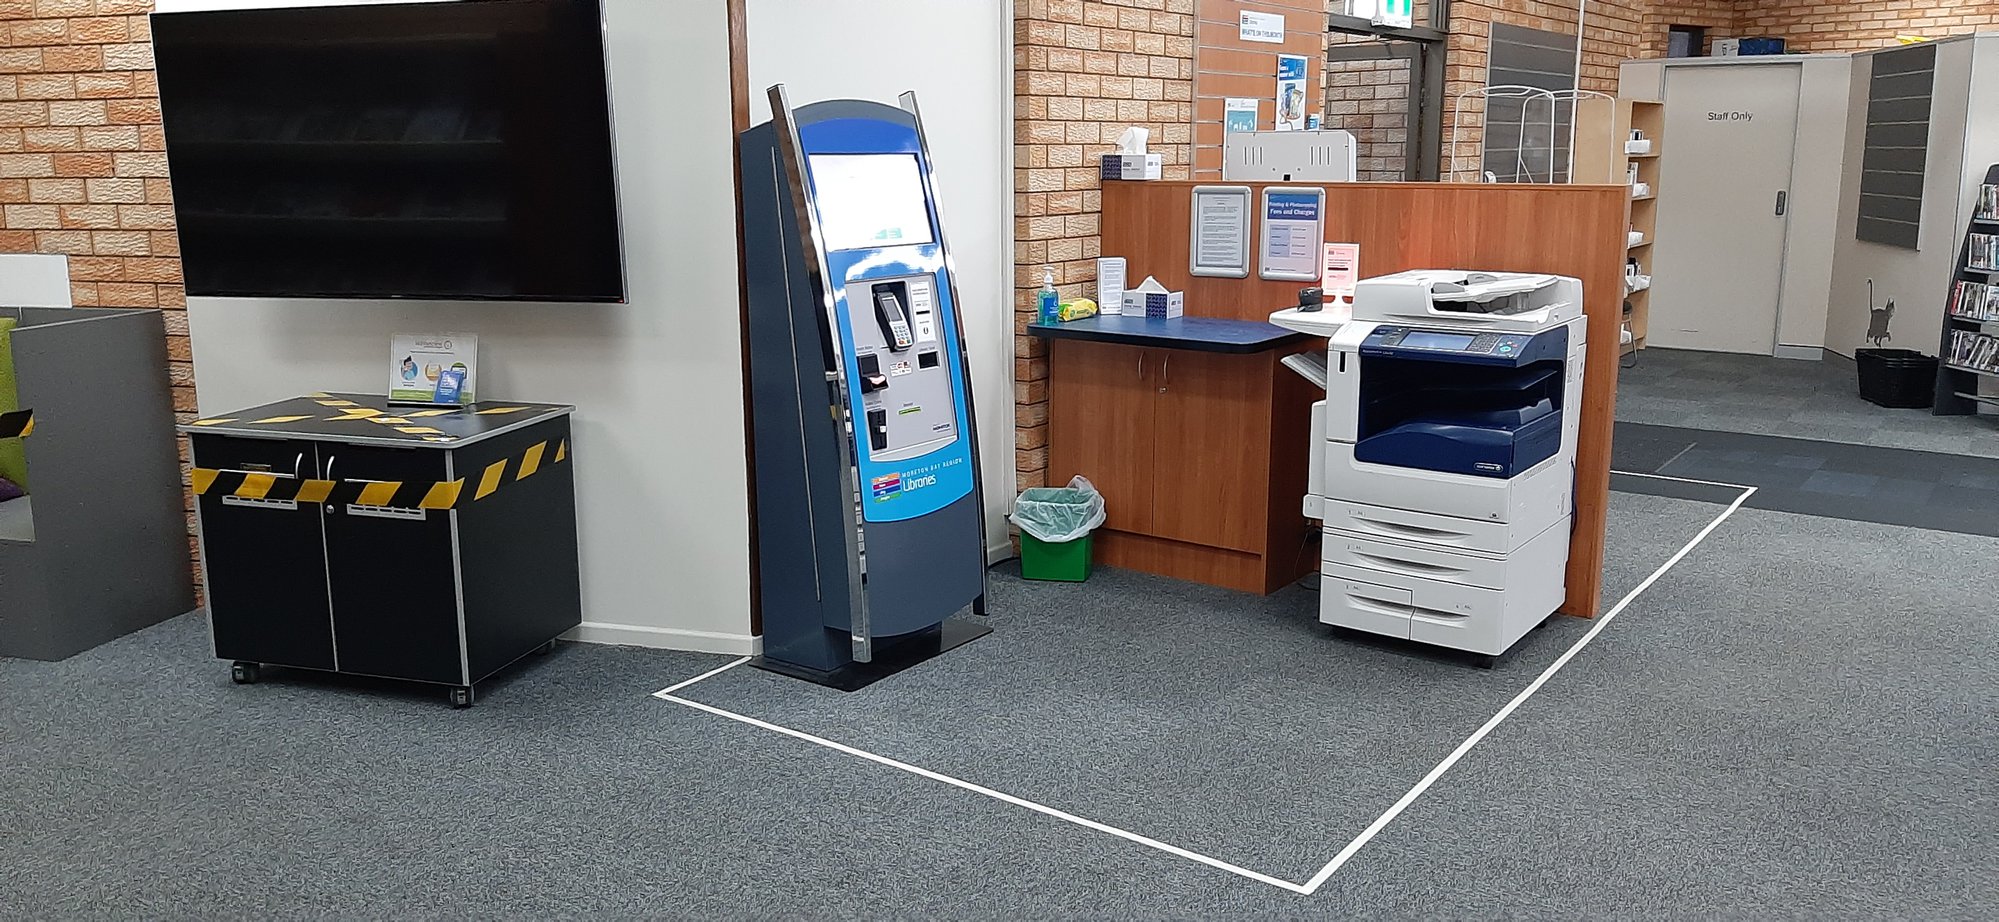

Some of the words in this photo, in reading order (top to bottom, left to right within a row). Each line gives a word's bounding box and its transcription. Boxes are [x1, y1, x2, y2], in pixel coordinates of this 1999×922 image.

[1707, 112, 1729, 121] Staff
[1731, 111, 1753, 122] Only
[901, 466, 929, 478] MORETON
[930, 463, 940, 471] BAY
[942, 457, 963, 468] REGION
[902, 474, 937, 492] Libraries
